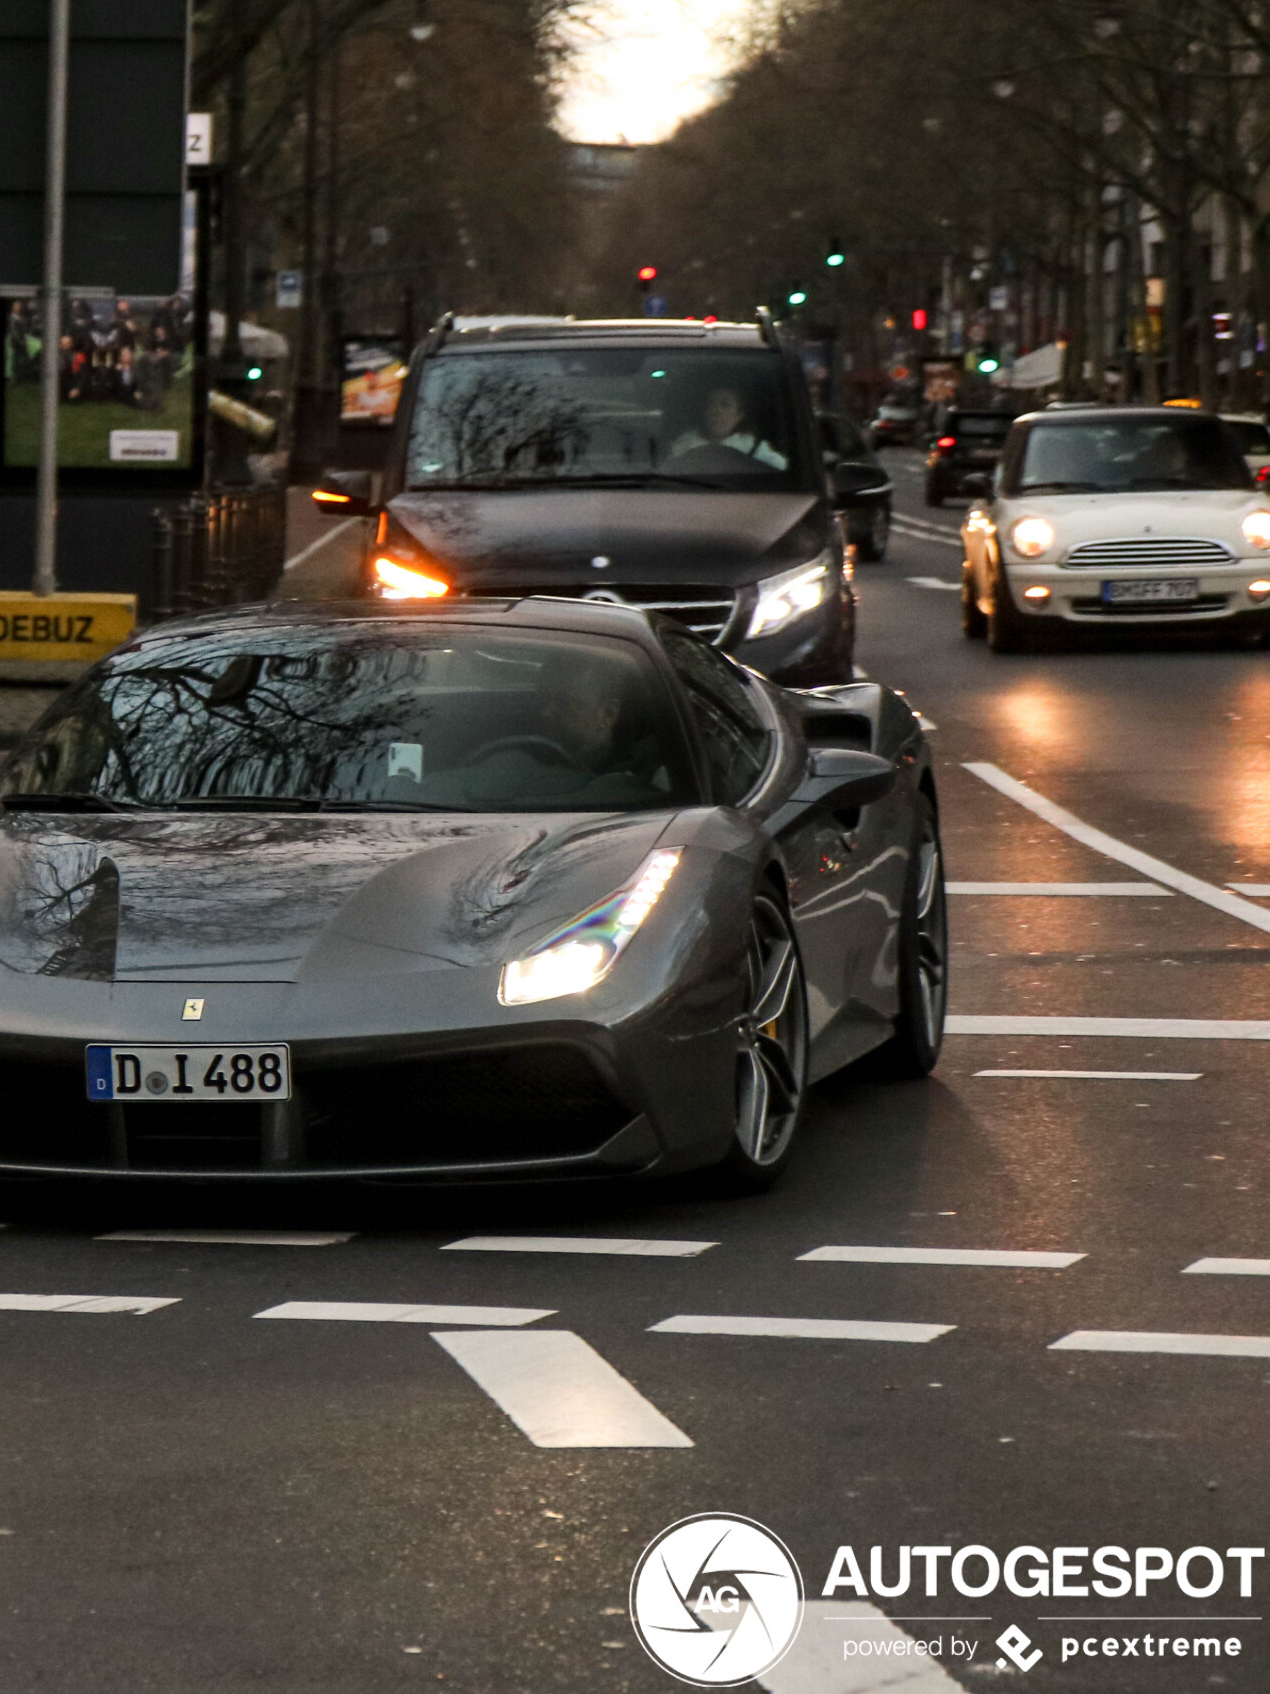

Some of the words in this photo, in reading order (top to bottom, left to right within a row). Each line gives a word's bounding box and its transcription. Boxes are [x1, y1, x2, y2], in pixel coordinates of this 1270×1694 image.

[96, 1078, 106, 1090] D
[114, 1053, 141, 1094] D
[172, 1053, 194, 1094] I
[202, 1052, 283, 1094] 488
